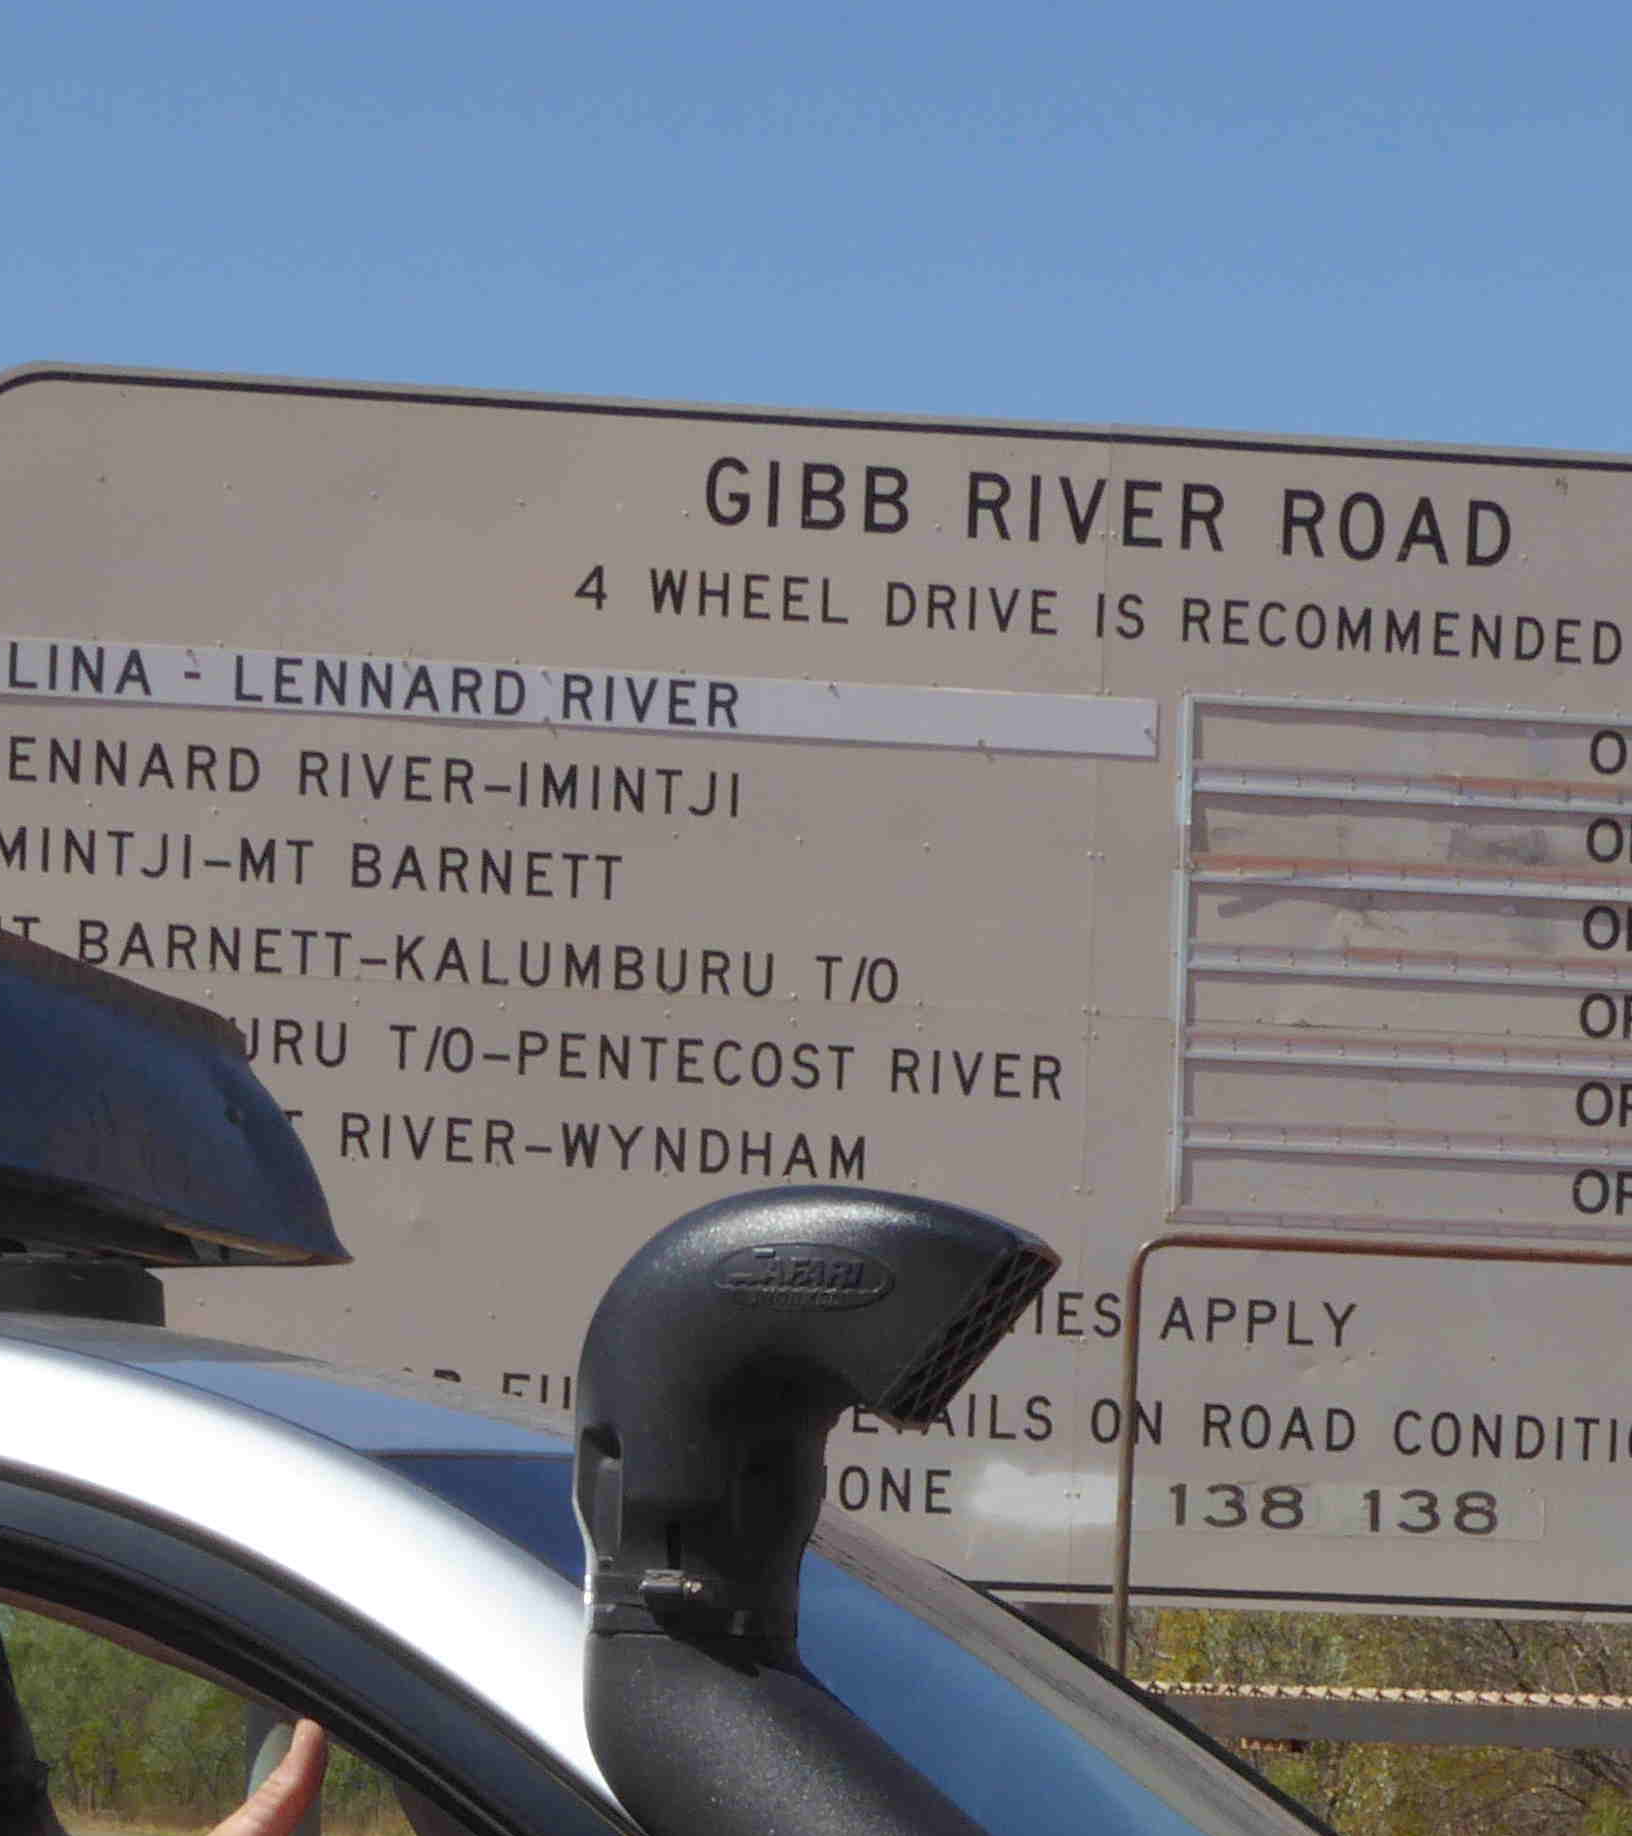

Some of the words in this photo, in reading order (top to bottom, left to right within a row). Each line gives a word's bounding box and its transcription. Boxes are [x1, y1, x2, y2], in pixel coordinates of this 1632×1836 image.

[704, 456, 910, 534] GIBB
[967, 471, 1225, 552] RIVER
[1281, 488, 1512, 567] ROAD
[574, 565, 608, 611] 4
[649, 567, 850, 625] WHEEL
[885, 582, 1058, 635] DRIVE
[1096, 593, 1145, 640] IS
[1181, 598, 1624, 666] RECOMMENDED
[234, 655, 527, 717] LENNARD
[561, 673, 740, 728] RIVER
[351, 843, 623, 900] BARNETT
[815, 955, 899, 1004] T/O
[890, 1048, 1063, 1100] RIVER
[1159, 1296, 1358, 1347] APPLY
[1090, 1398, 1165, 1444] ON
[1202, 1403, 1357, 1452] ROAD
[822, 1463, 953, 1515] ONE
[1168, 1482, 1305, 1530] 138
[1362, 1488, 1500, 1535] 138
